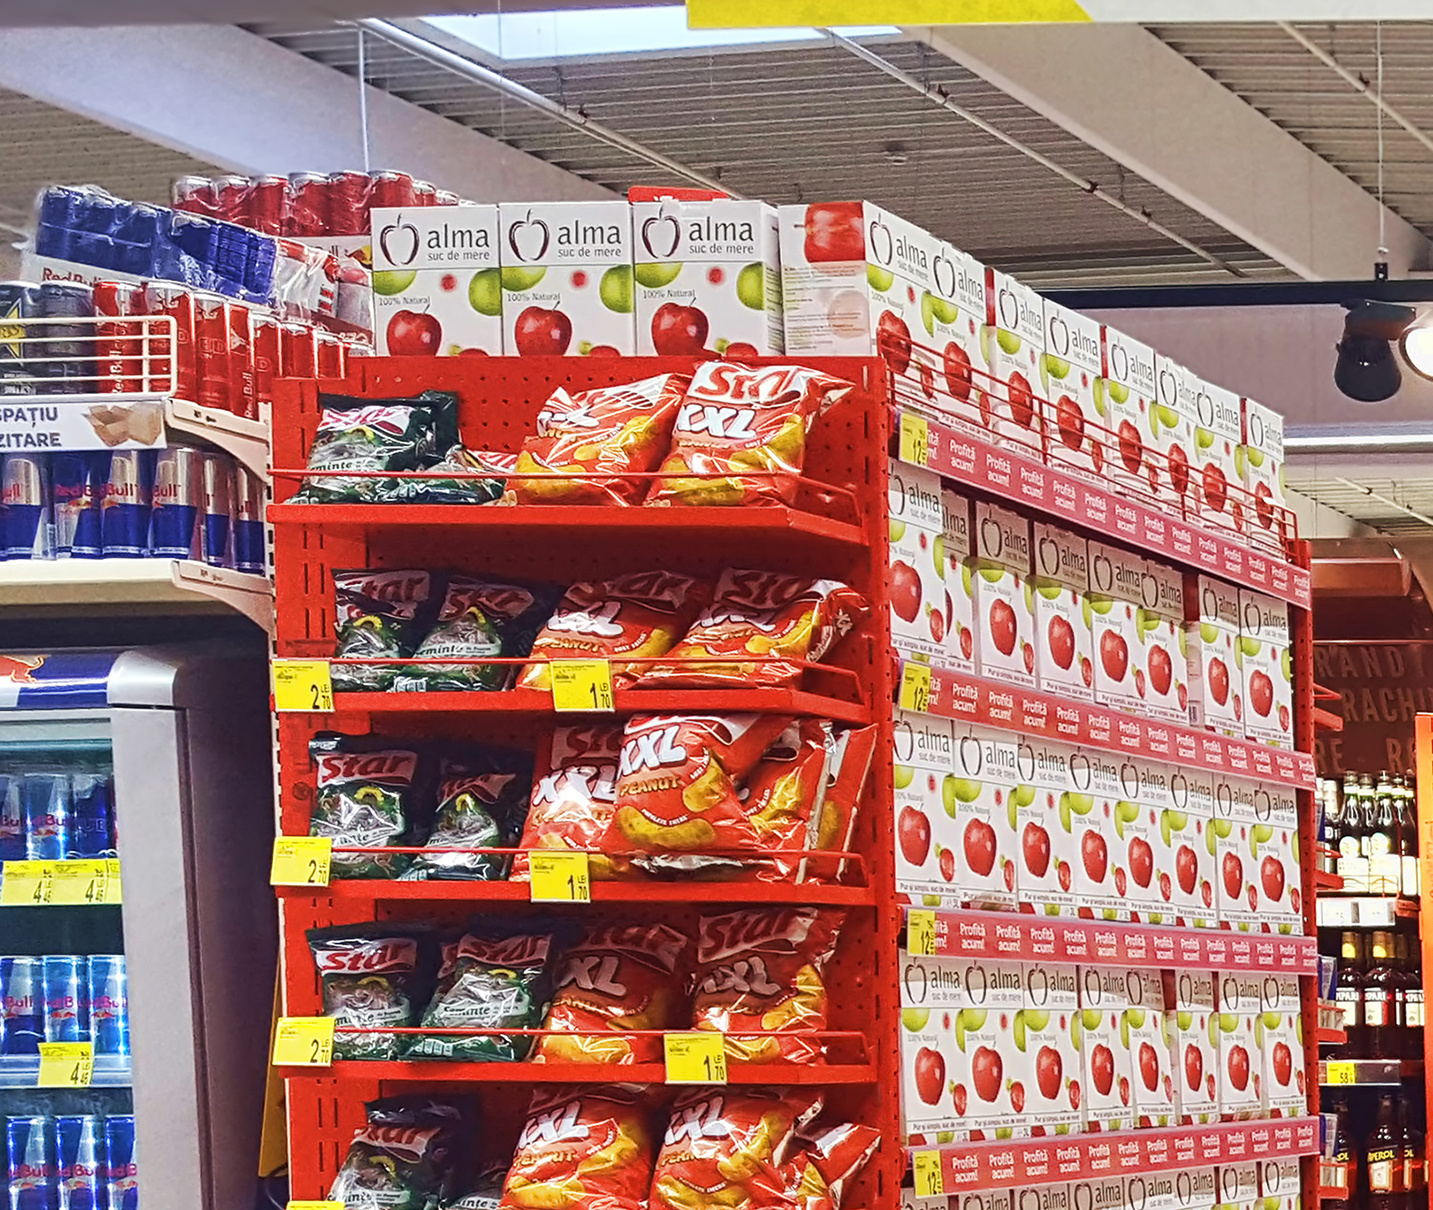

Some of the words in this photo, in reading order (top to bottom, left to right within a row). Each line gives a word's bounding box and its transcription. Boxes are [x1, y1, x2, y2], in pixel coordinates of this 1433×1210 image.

[427, 223, 489, 249] alma
[558, 220, 622, 245] alma
[689, 218, 753, 242] alma
[427, 251, 444, 261] suc
[447, 251, 459, 261] de
[463, 251, 490, 261] mere
[558, 247, 575, 258] suc
[578, 246, 591, 257] de
[594, 247, 622, 258] mere
[689, 243, 707, 254] suc
[710, 243, 722, 253] de
[726, 244, 754, 254] mere
[909, 487, 940, 512] alma
[310, 684, 320, 710] 2
[589, 682, 597, 710] 1
[616, 717, 687, 778] XXL
[917, 731, 951, 753] alma
[620, 776, 679, 797] PEANUT
[308, 859, 316, 884] 2
[568, 874, 576, 900] 1
[930, 971, 960, 990] alma
